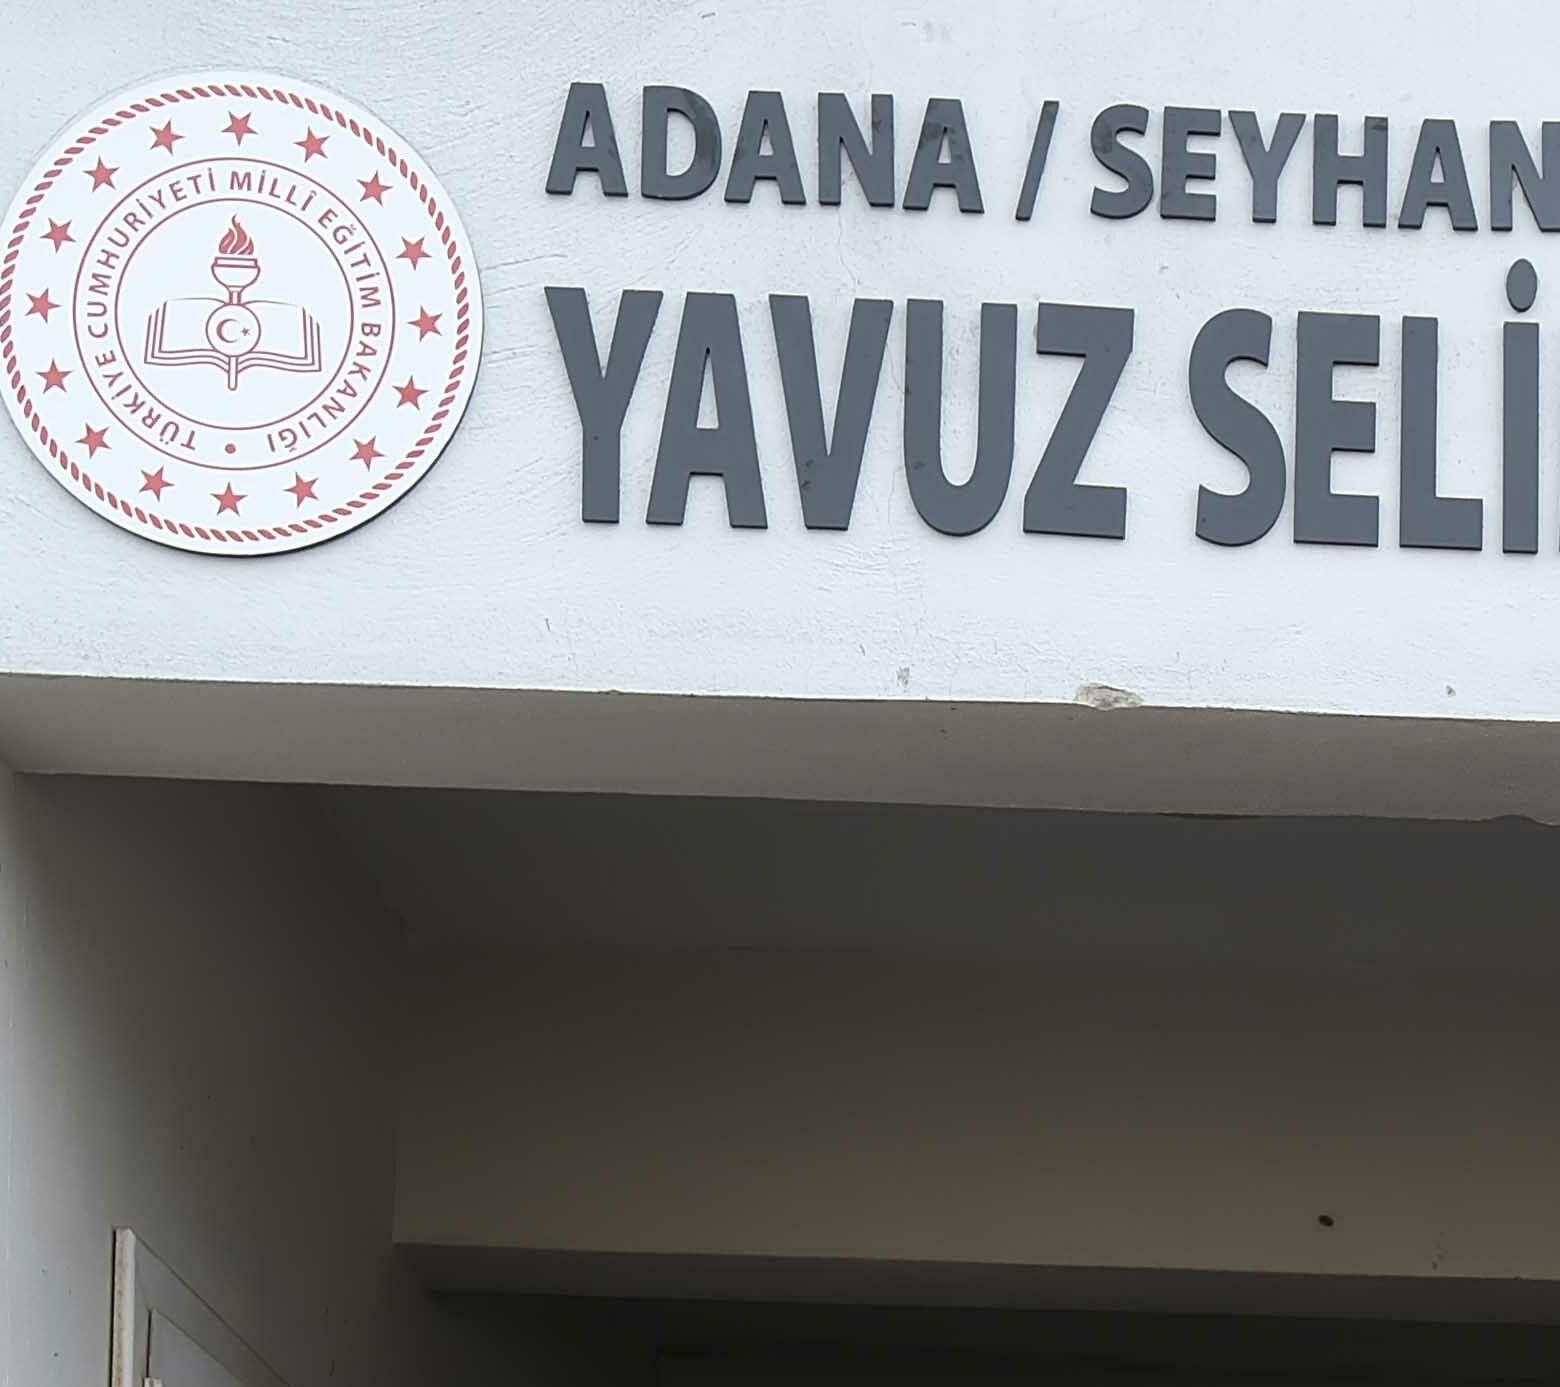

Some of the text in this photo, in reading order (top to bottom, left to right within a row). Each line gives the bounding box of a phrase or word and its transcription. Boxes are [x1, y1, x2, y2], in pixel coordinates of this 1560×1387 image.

[545, 82, 984, 214] ADANA
[1015, 101, 1059, 222] /
[87, 167, 215, 338] CUMHURİYETİ
[318, 208, 381, 308] EĞİTİM
[96, 350, 197, 450] TÜRKİYE
[267, 323, 381, 453] BAKANLIĞI
[544, 287, 1134, 540] YAVUZ
